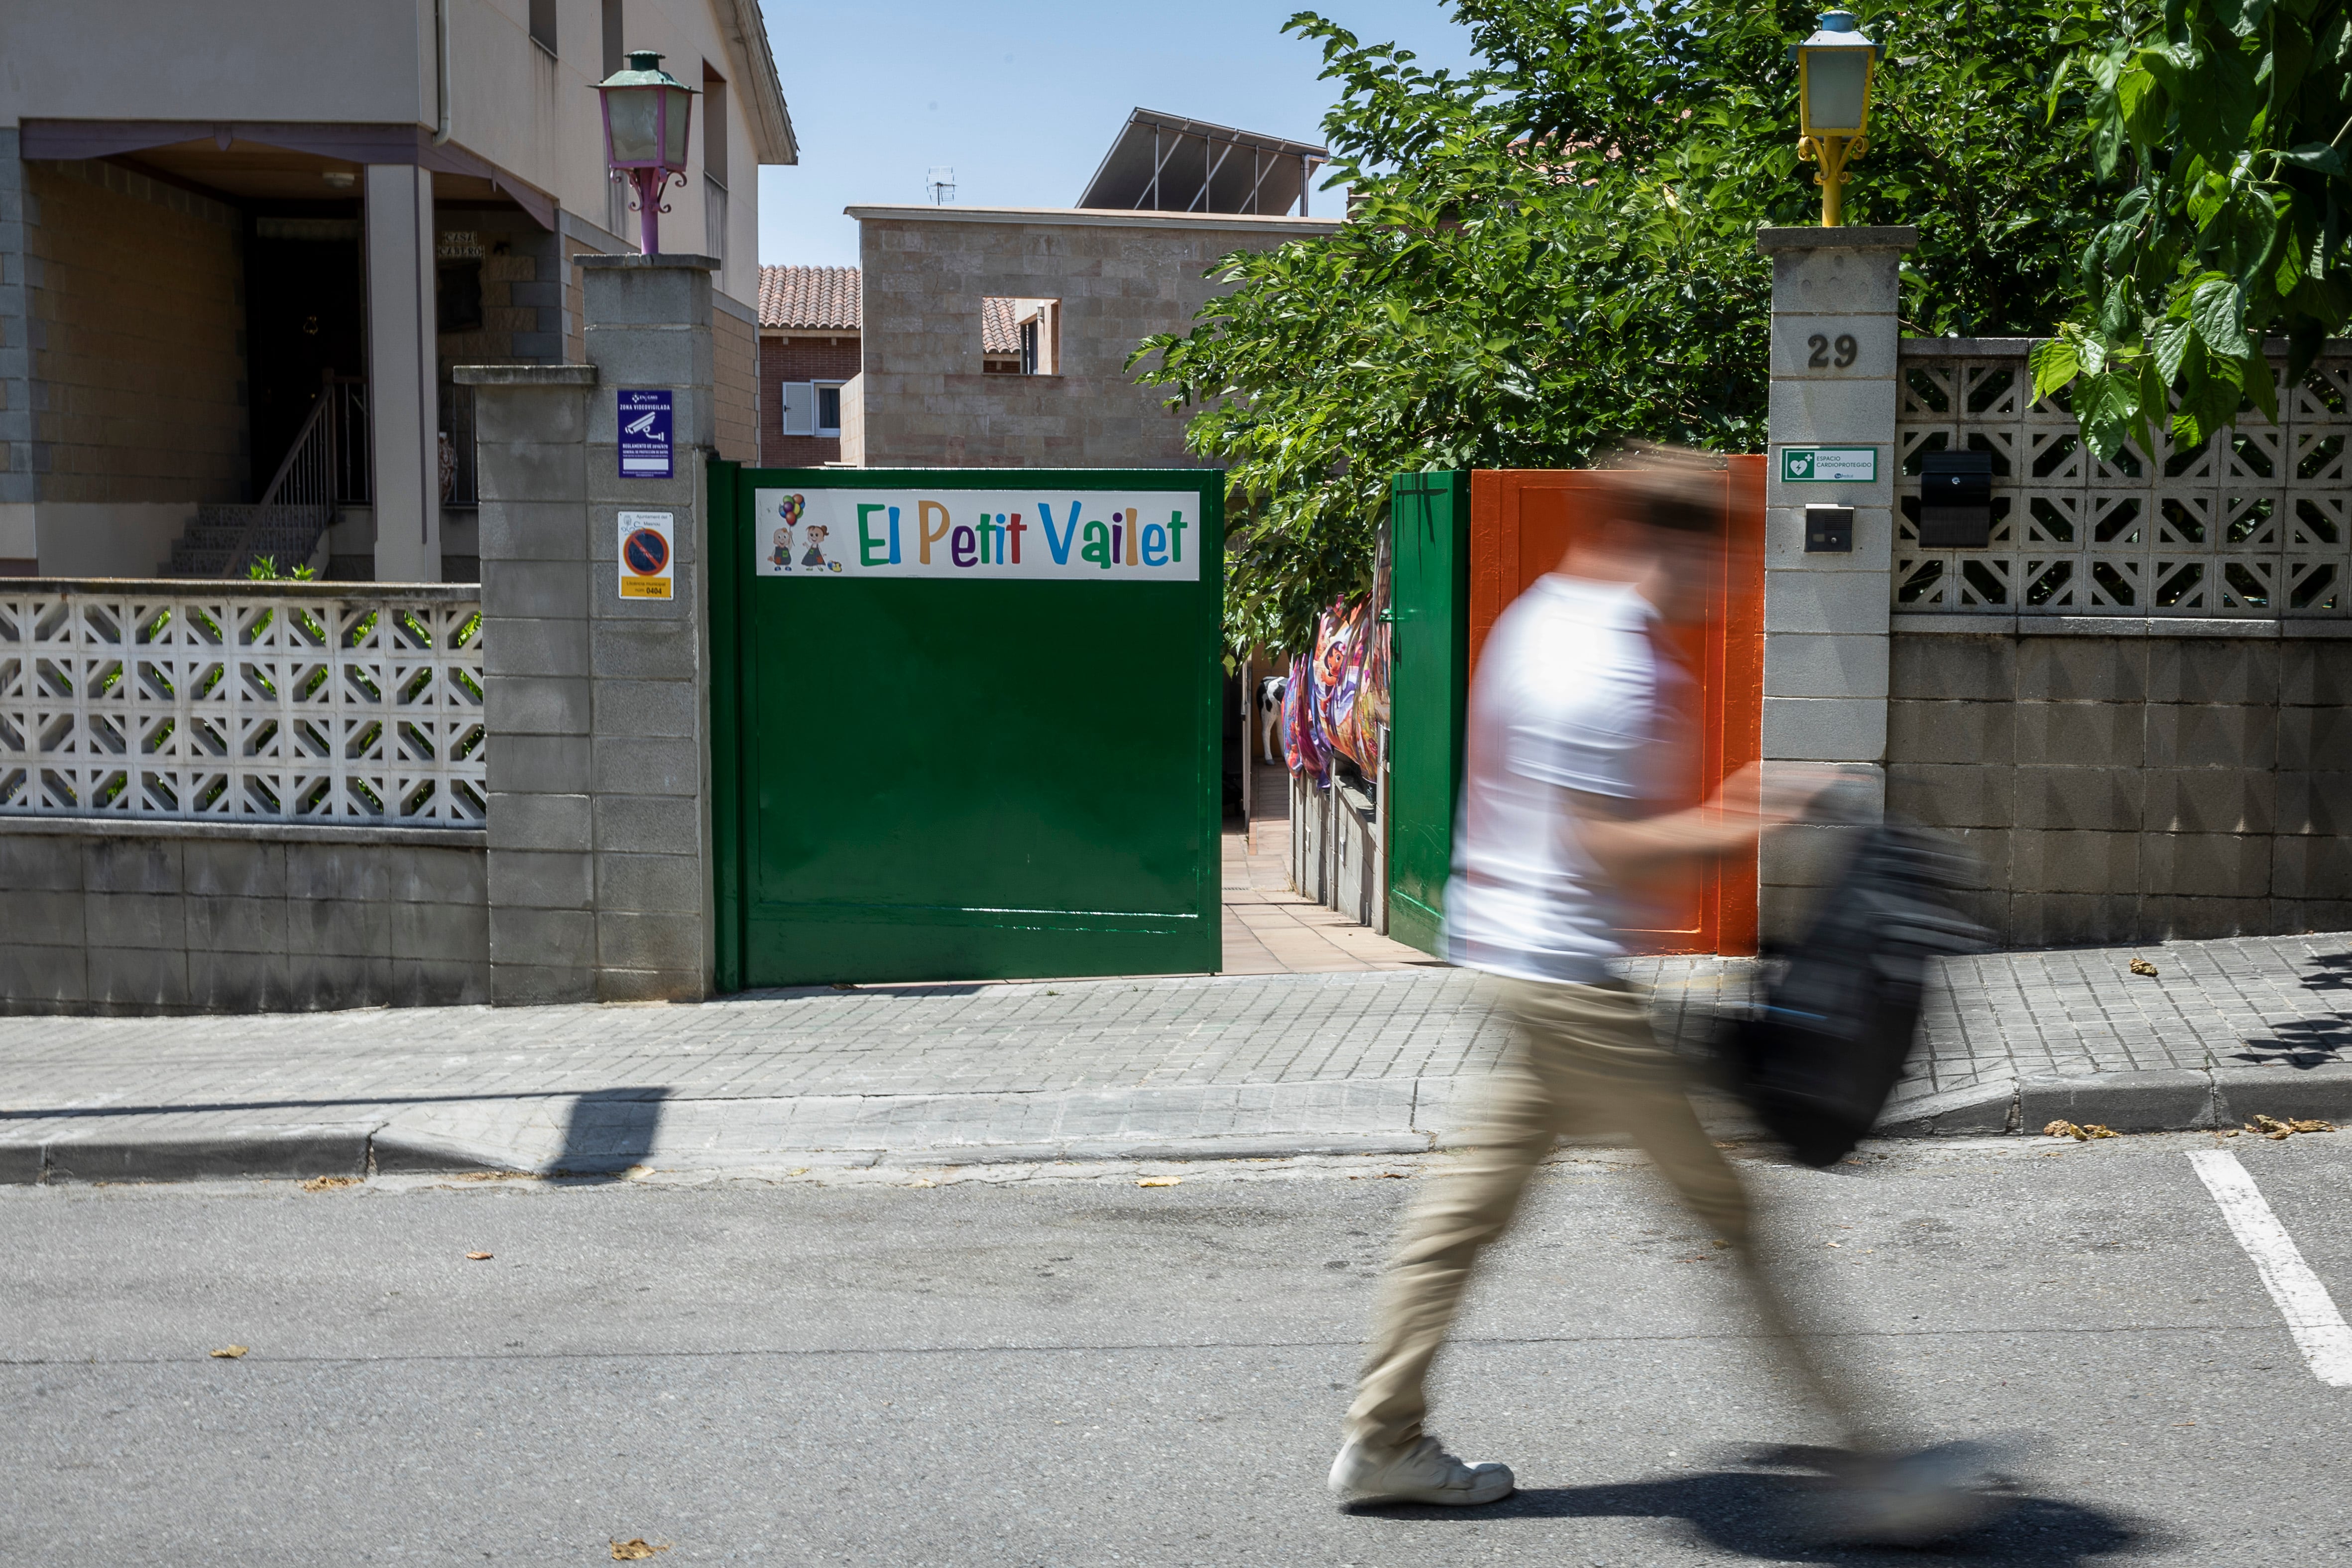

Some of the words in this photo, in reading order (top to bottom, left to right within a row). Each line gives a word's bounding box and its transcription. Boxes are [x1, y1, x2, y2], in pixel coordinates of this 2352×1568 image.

[446, 233, 472, 241] CASA
[1808, 334, 1858, 368] 29
[857, 503, 901, 567] El
[918, 500, 1027, 568] Petit
[1038, 500, 1188, 570] Vailet
